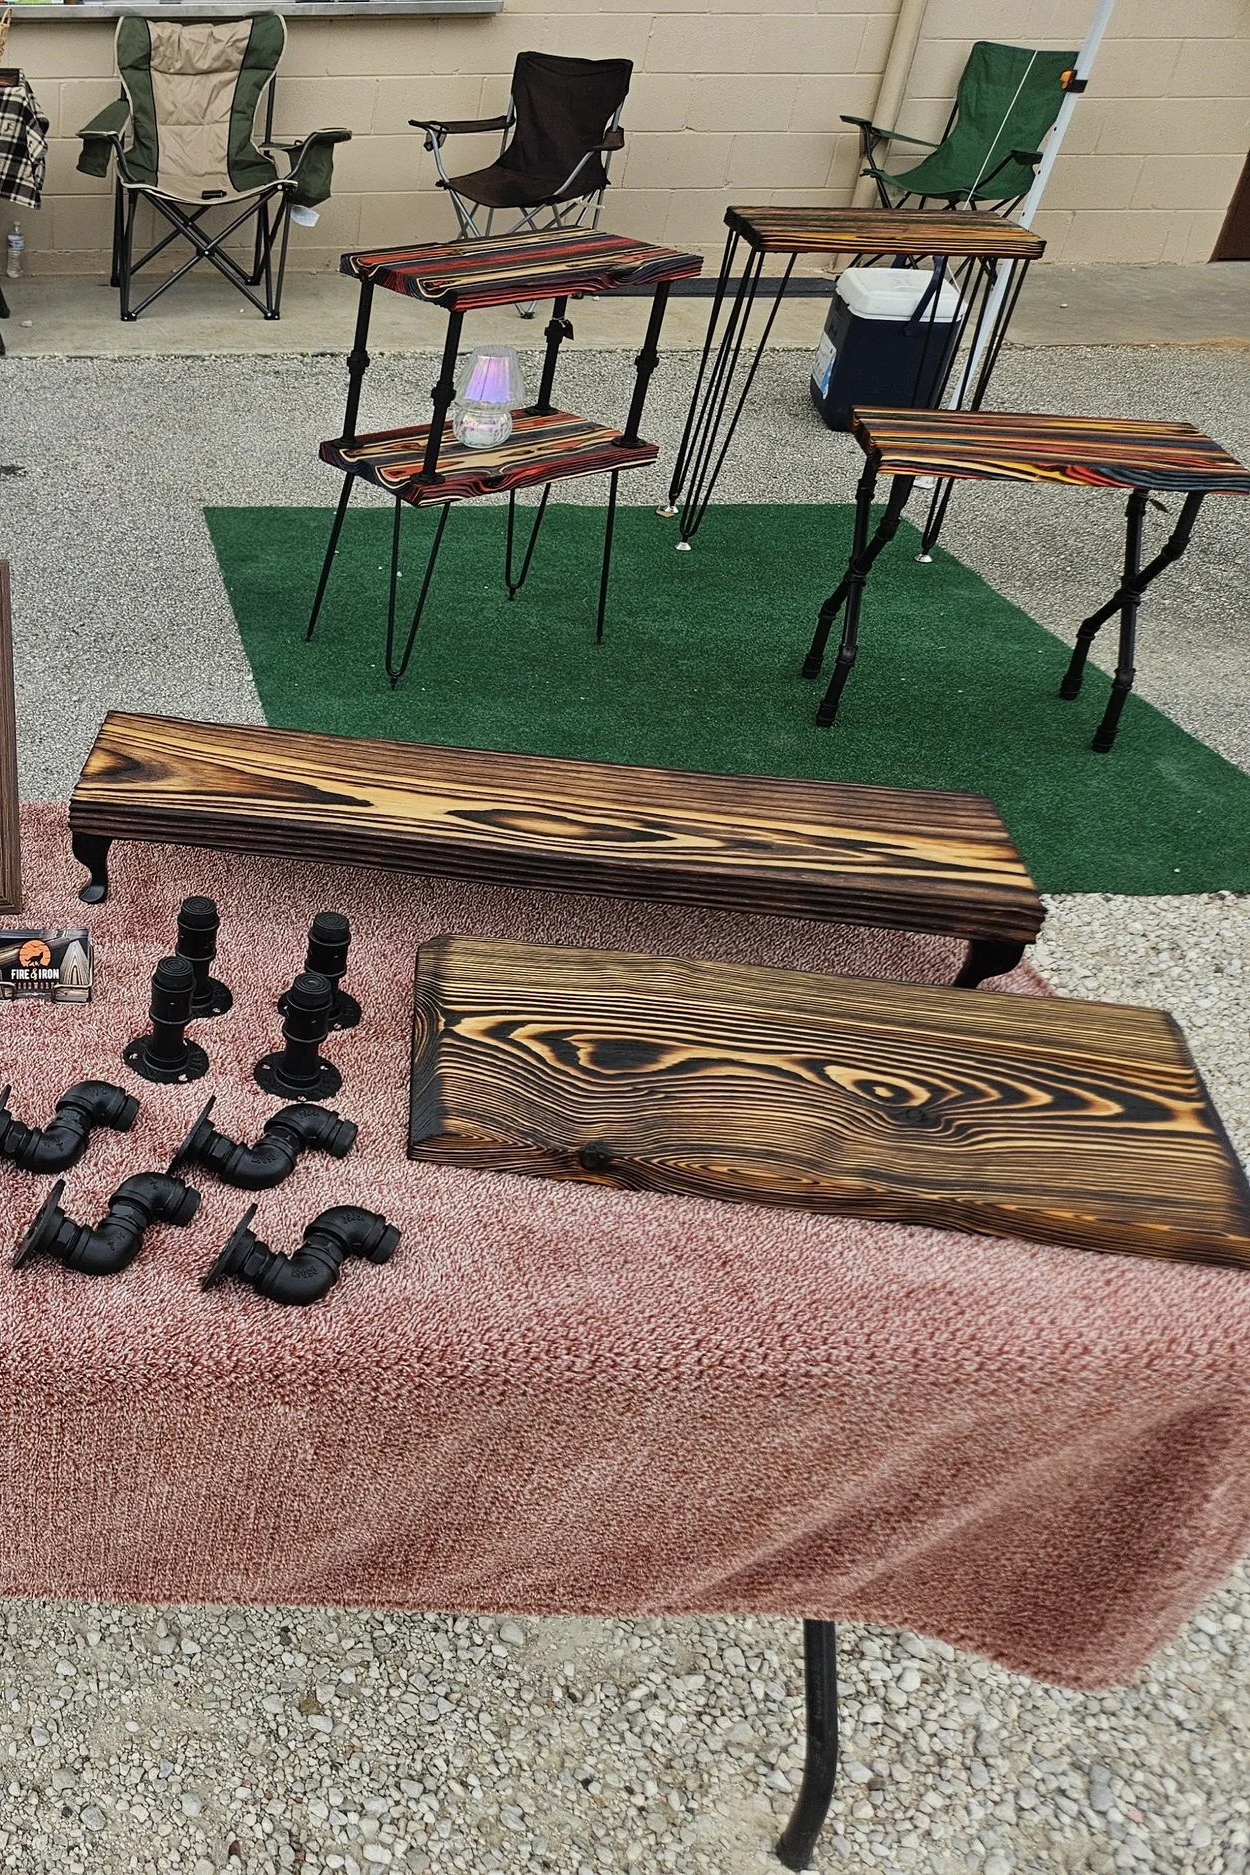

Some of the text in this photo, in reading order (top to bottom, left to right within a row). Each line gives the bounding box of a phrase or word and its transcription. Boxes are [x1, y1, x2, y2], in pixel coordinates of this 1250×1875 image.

[11, 967, 60, 981] FIRE & IRON
